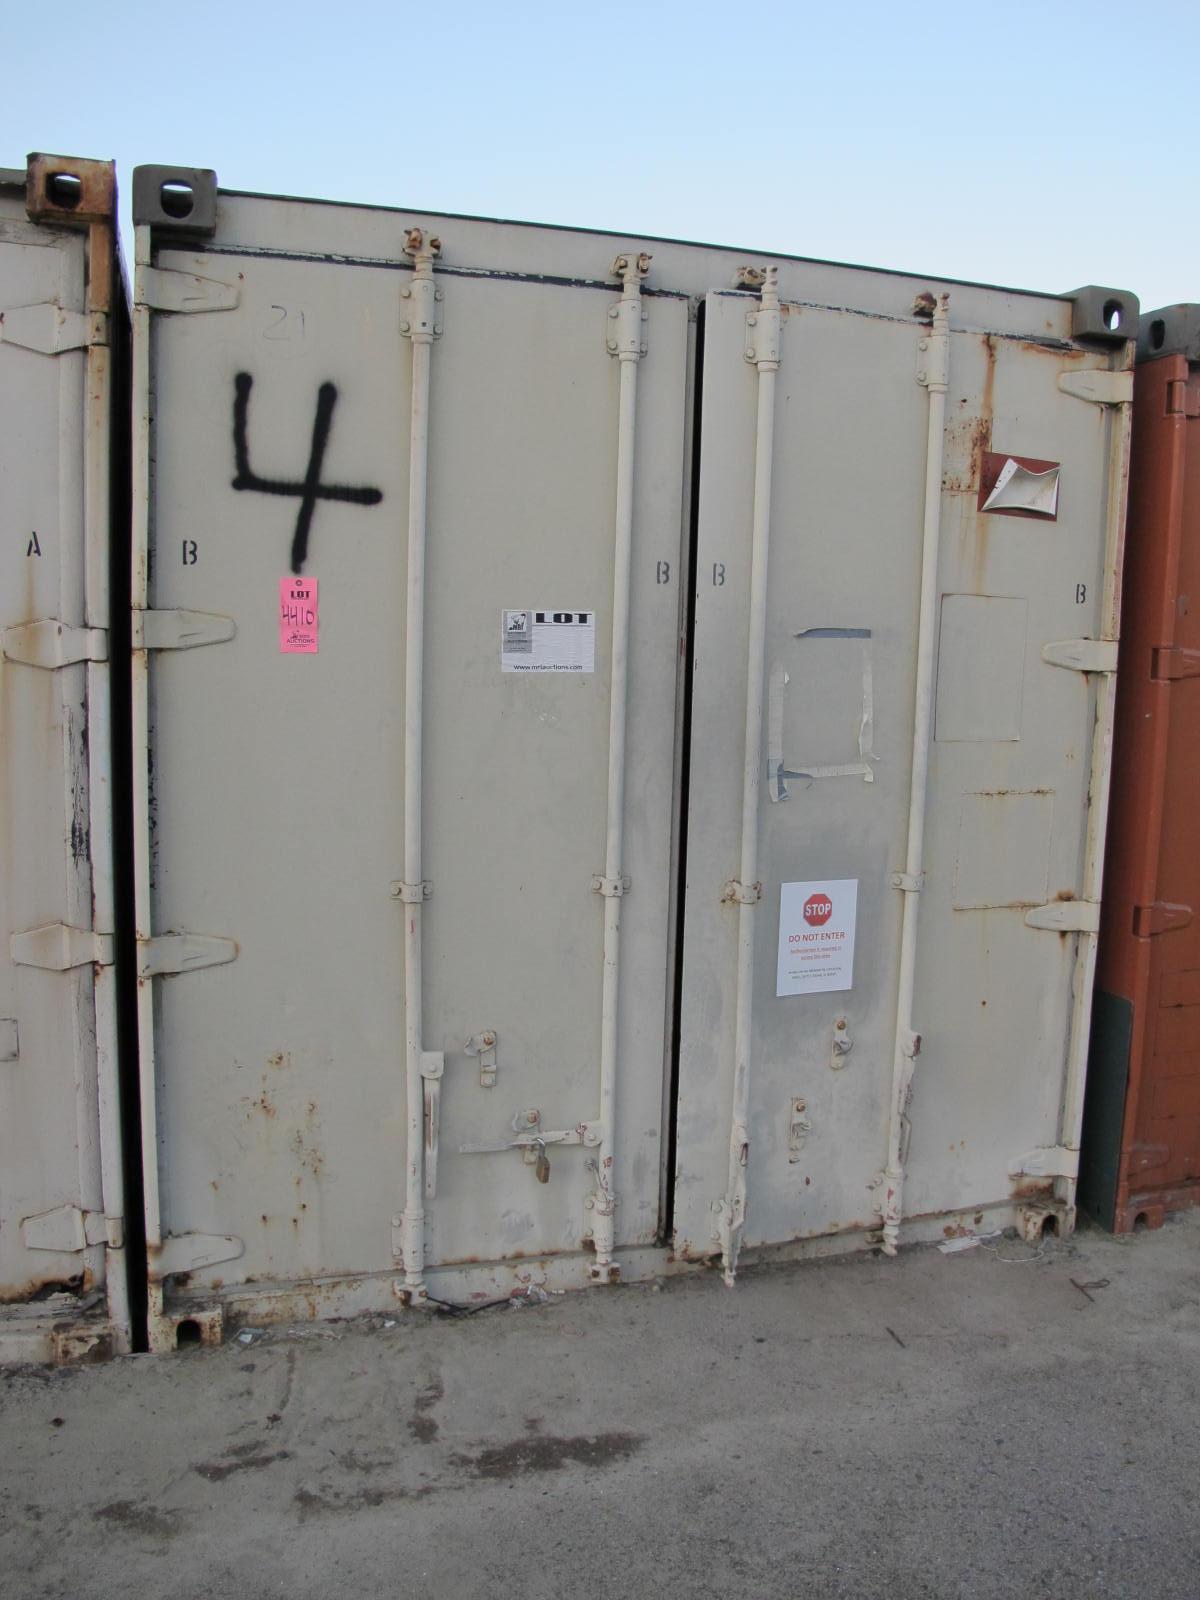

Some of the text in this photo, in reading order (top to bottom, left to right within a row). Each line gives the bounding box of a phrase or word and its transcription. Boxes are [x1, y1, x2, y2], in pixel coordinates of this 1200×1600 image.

[231, 371, 383, 574] 4
[26, 531, 42, 557] A
[182, 540, 198, 565] B
[656, 561, 670, 585] B
[712, 563, 726, 586] B
[1075, 583, 1087, 604] B
[282, 605, 315, 626] 4410
[536, 613, 592, 624] LOT
[805, 903, 831, 916] STOP
[788, 931, 845, 943] DO NOT ENTER
